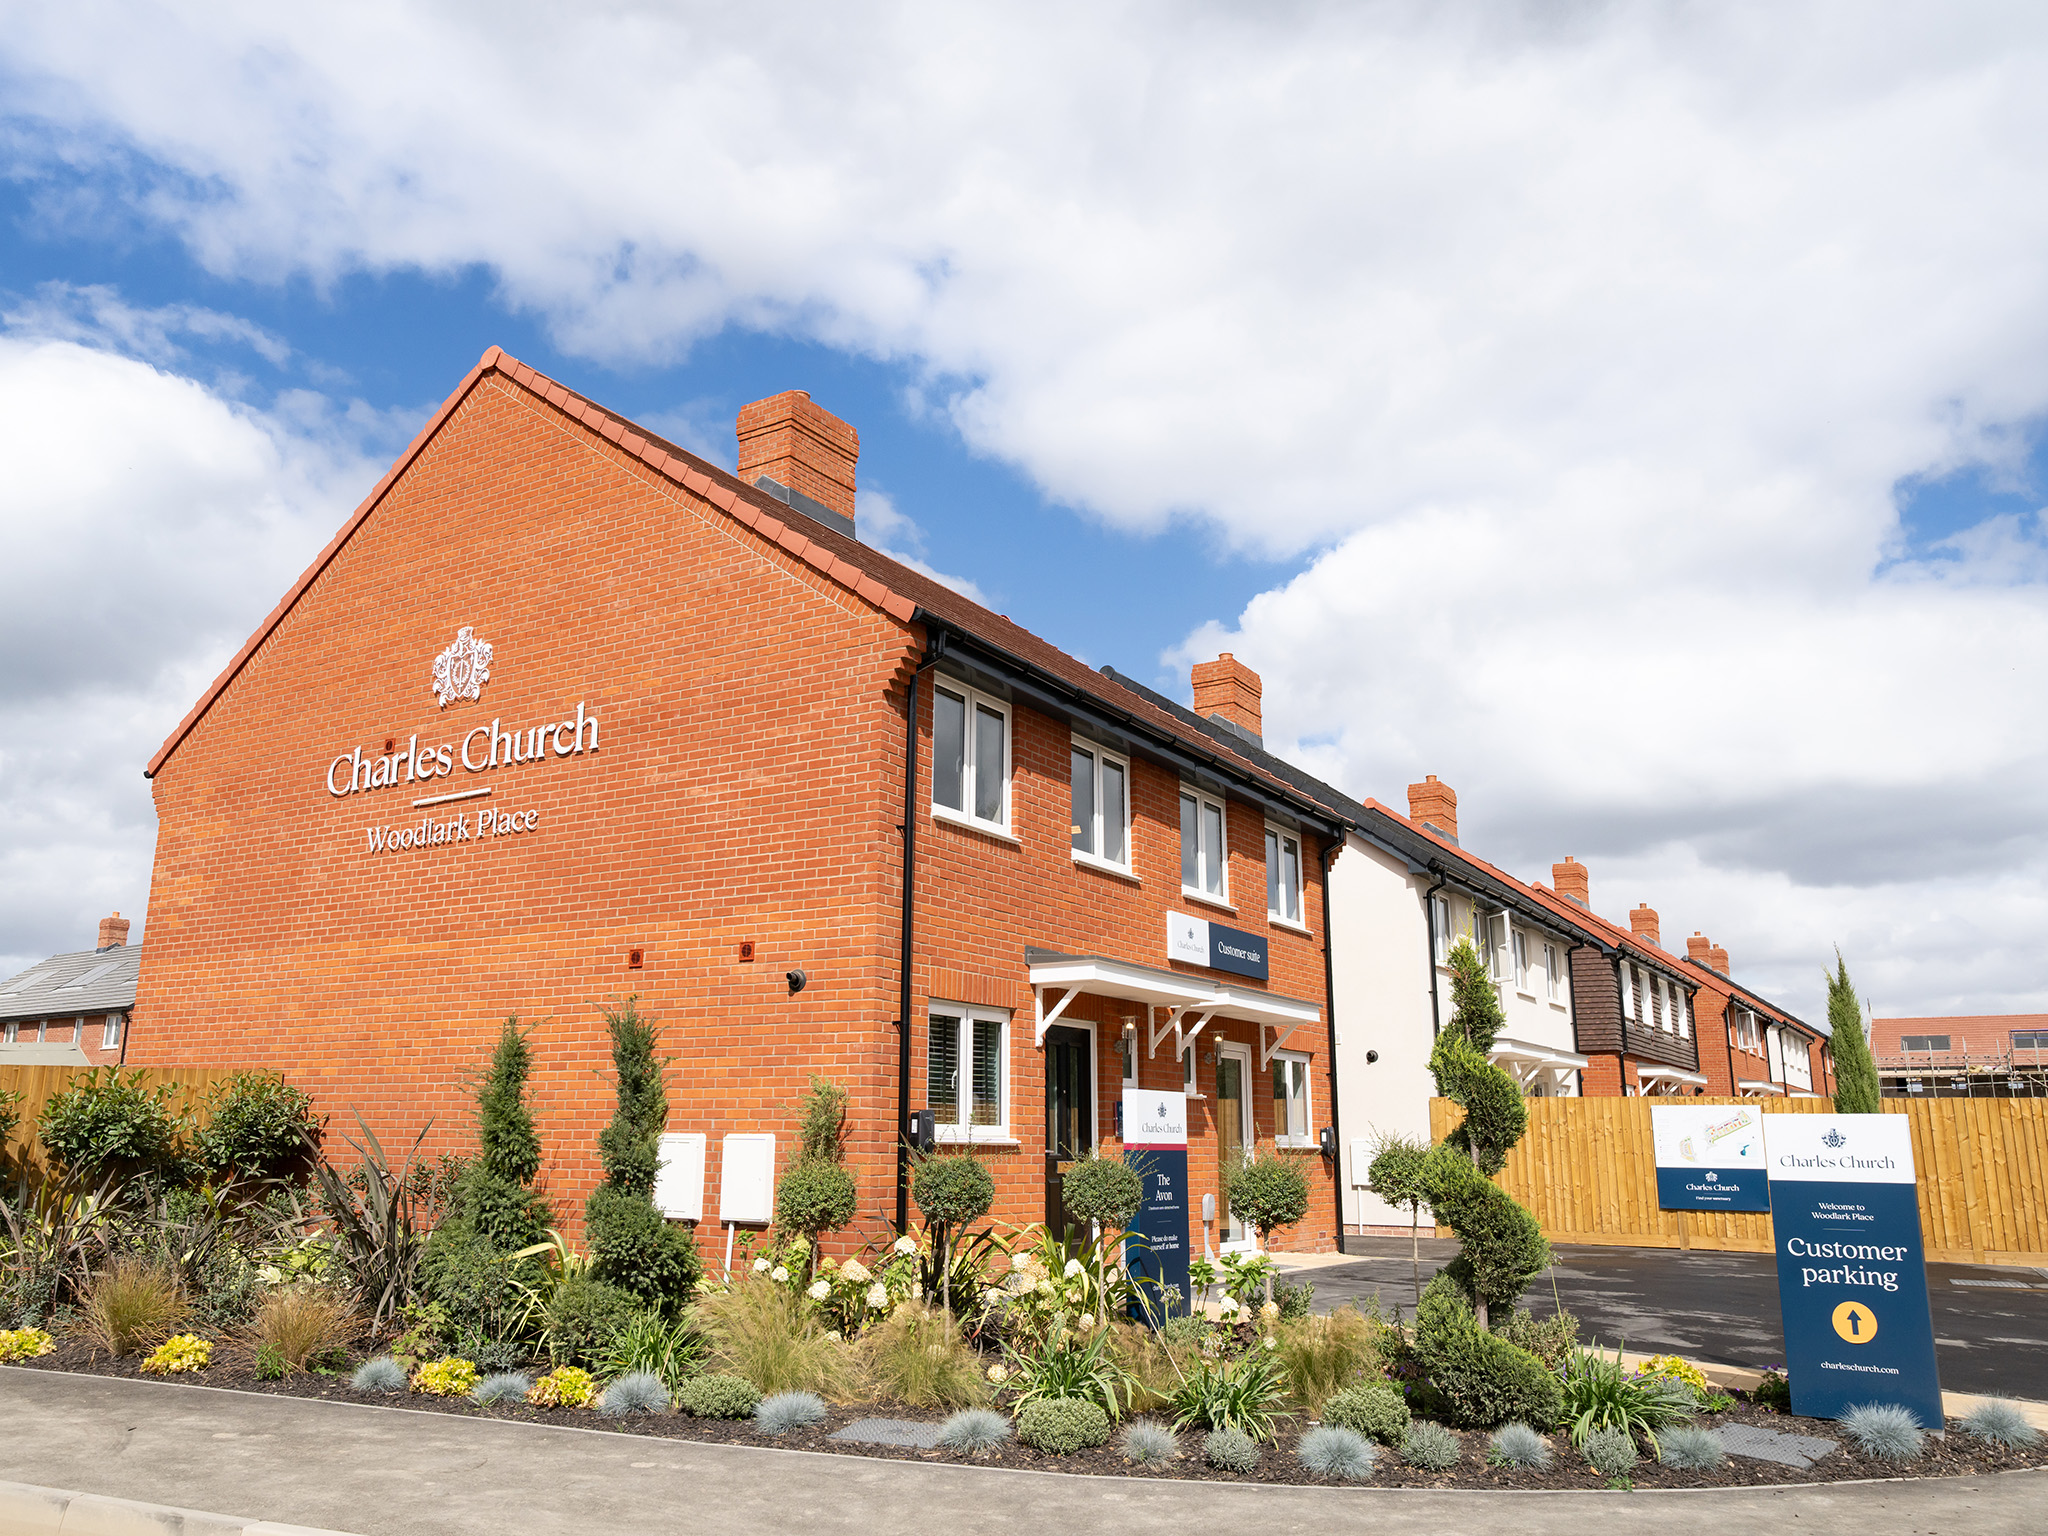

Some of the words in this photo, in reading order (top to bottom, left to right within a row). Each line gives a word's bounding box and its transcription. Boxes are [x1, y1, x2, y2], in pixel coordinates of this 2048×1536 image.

[327, 734, 453, 797] Charles
[461, 701, 599, 773] Church
[366, 813, 470, 854] Woodlark
[477, 807, 539, 839] Place
[1218, 941, 1246, 959] Customer
[1247, 949, 1261, 963] suite
[1142, 1122, 1163, 1133] Charles
[1163, 1123, 1182, 1134] Church
[1780, 1154, 1836, 1168] Charles
[1839, 1155, 1895, 1169] Church
[1157, 1174, 1171, 1186] The
[1713, 1184, 1740, 1192] Church
[1155, 1190, 1173, 1201] Avon
[1818, 1202, 1855, 1211] Welcome
[1811, 1211, 1851, 1220] Woodlark
[1851, 1213, 1875, 1221] Place
[1787, 1237, 1908, 1261] Customer
[1801, 1265, 1899, 1292] parking
[1820, 1361, 1899, 1375] charleschurch.com
